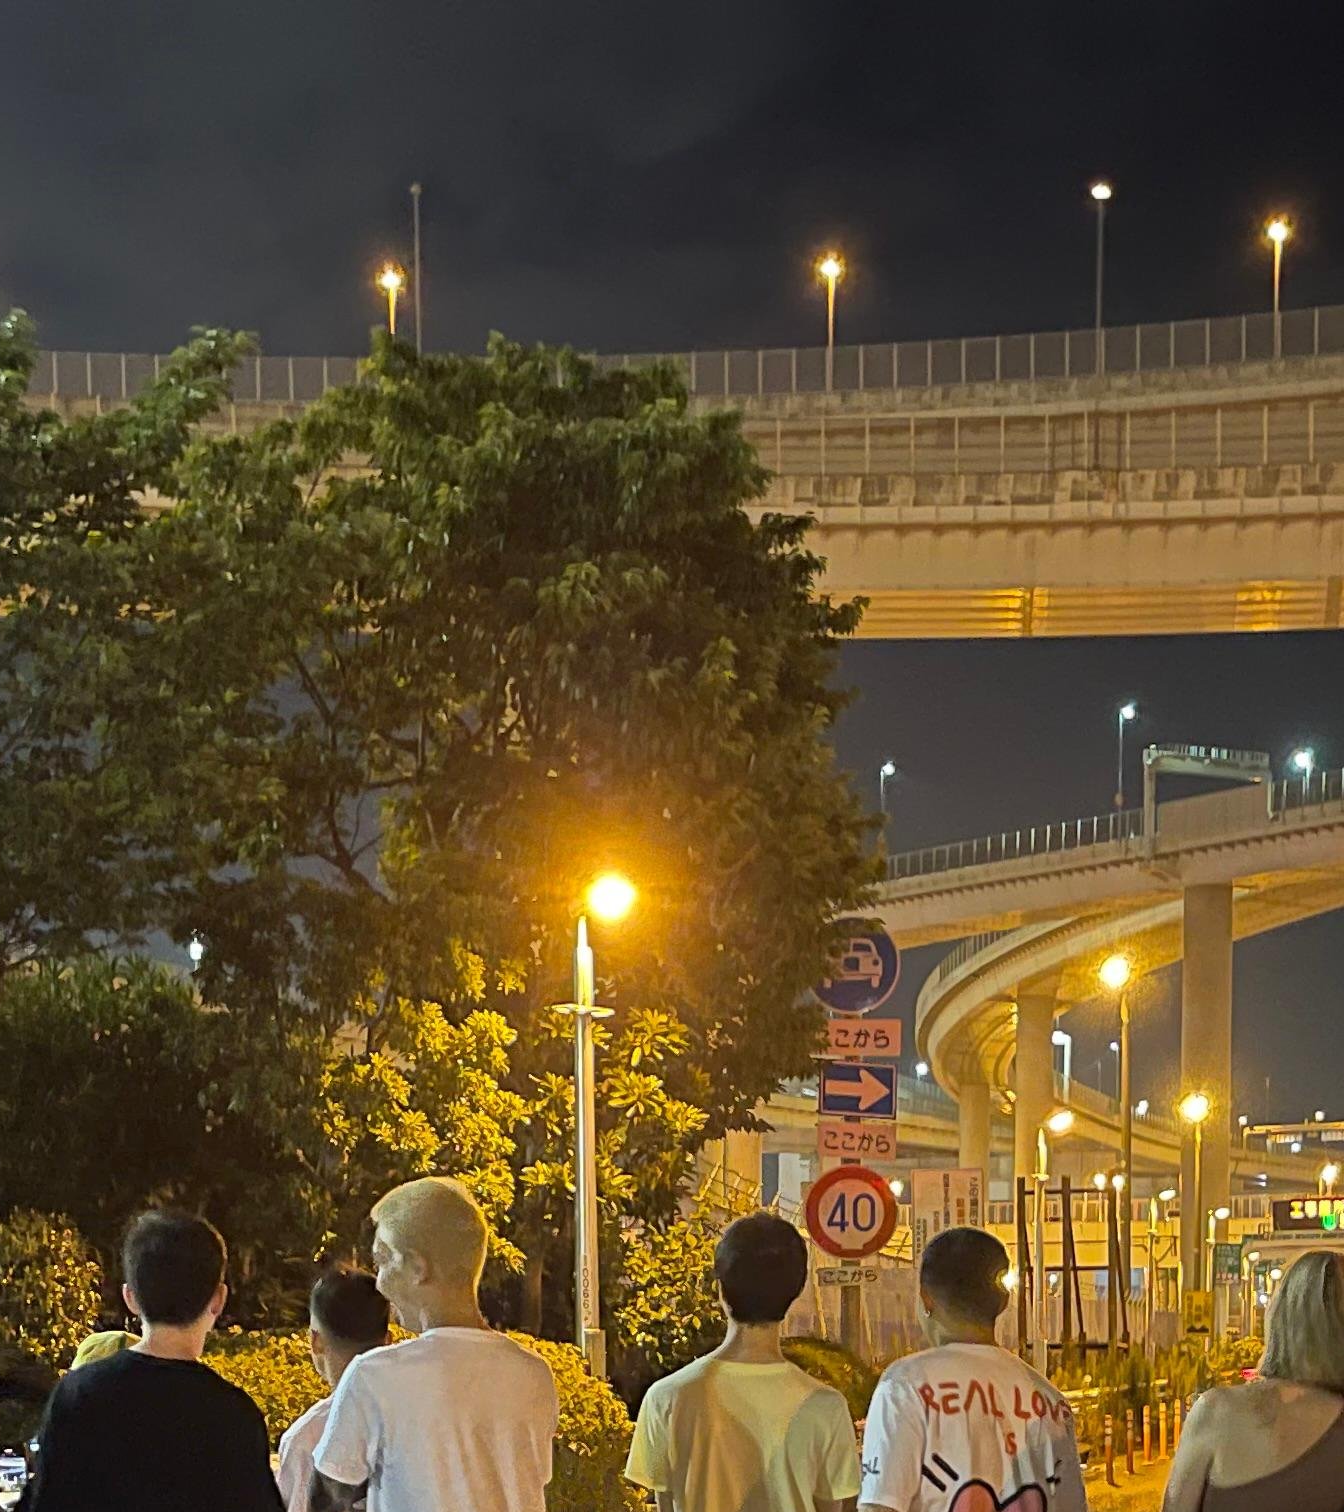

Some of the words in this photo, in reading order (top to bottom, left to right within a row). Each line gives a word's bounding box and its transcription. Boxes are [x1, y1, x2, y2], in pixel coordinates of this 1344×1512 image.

[827, 1028, 890, 1049] こから
[823, 1129, 890, 1154] ここから
[827, 1192, 876, 1233] 40
[822, 1269, 878, 1284] ここから
[918, 1378, 1005, 1418] REAL
